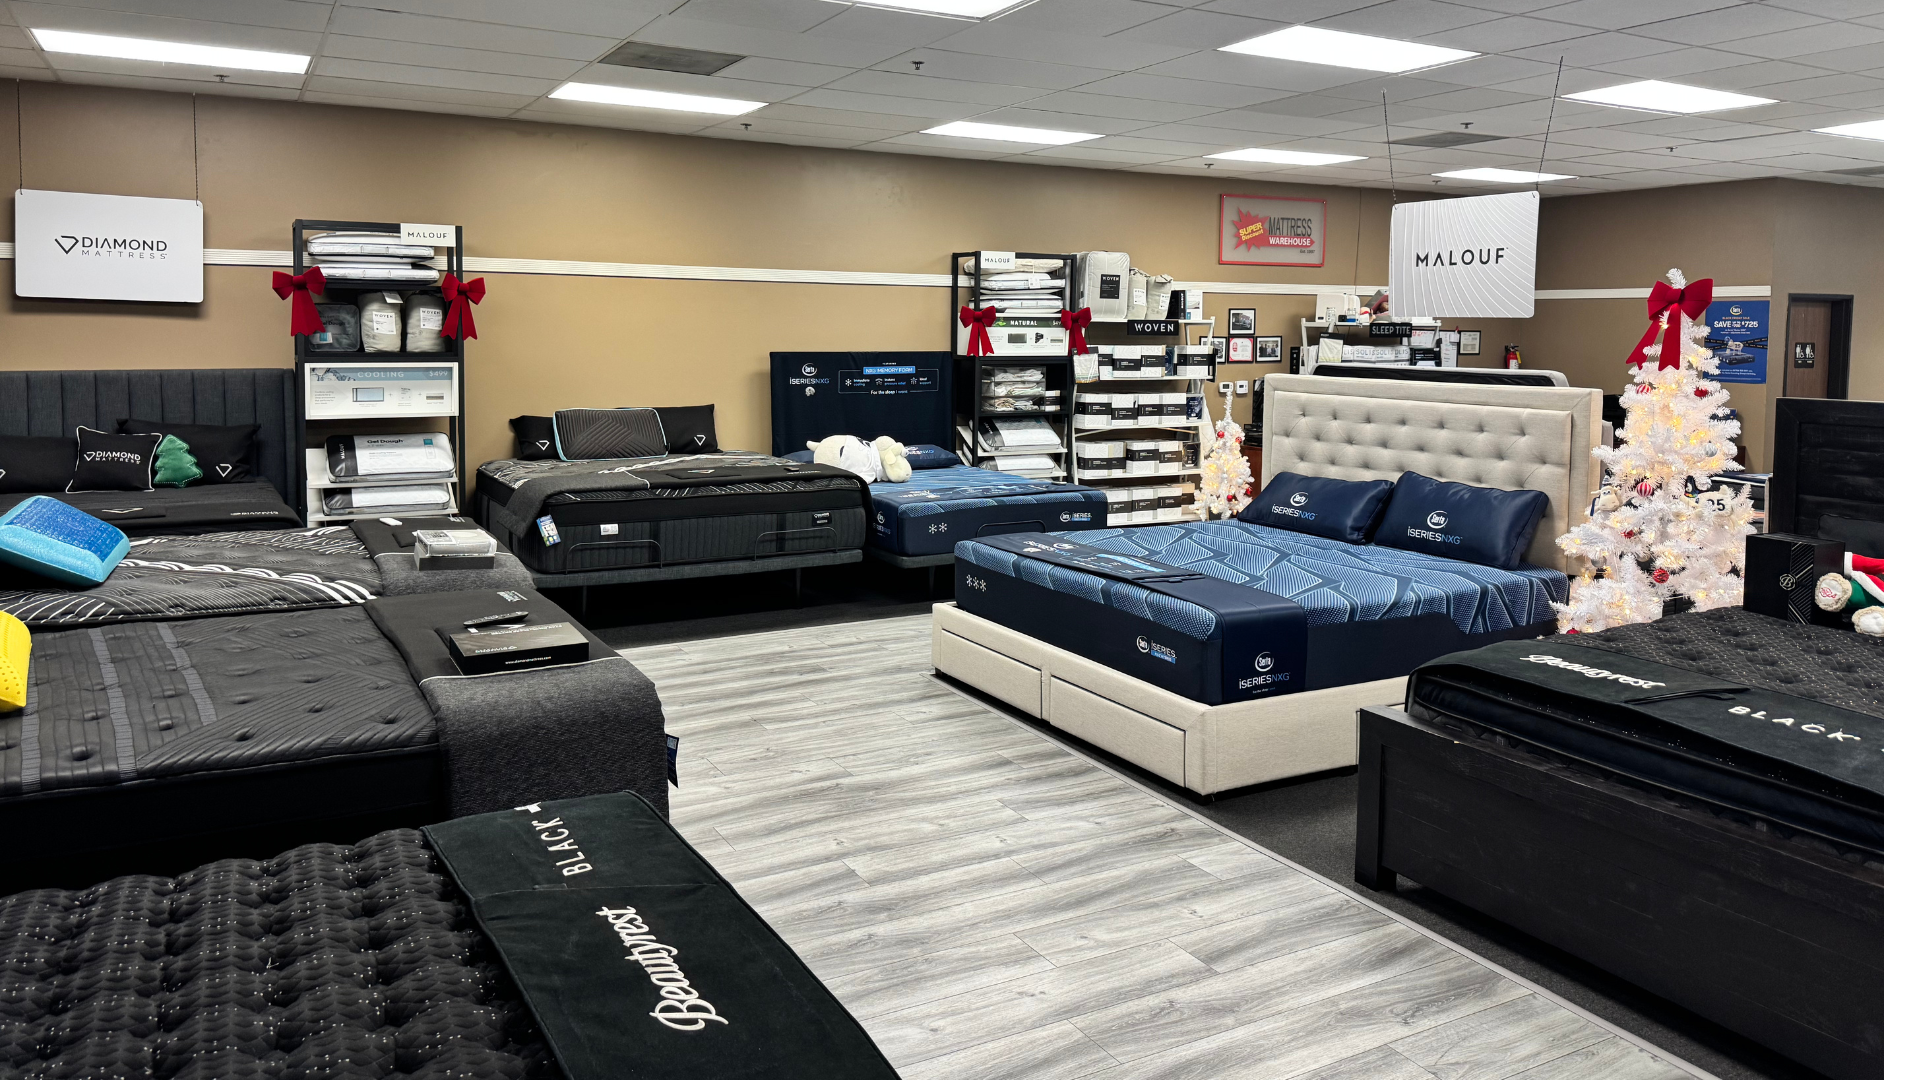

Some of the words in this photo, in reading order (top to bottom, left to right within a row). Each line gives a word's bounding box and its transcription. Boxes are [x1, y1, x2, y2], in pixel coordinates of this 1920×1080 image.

[1239, 222, 1263, 237] SUPER
[1268, 217, 1312, 237] MATTRESS
[407, 231, 447, 239] MALOUF
[1241, 229, 1264, 241] Discount
[1268, 236, 1311, 246] WAREHOUSE
[82, 236, 167, 252] DIAMOND
[81, 250, 166, 259] MATTRESS
[1415, 247, 1505, 267] MALOUF
[1134, 323, 1174, 332] WOVEN
[1714, 320, 1731, 328] SAVE
[1742, 320, 1758, 328] $725
[1371, 326, 1394, 335] SLEEP
[1396, 326, 1411, 334] TITE
[95, 457, 141, 465] MATTRESS
[96, 450, 141, 461] DIAMOND
[1519, 654, 1667, 689] Beautyrest
[1727, 705, 1856, 742] BLACK
[532, 817, 593, 877] BLACK
[595, 905, 729, 1031] Beautyrest
